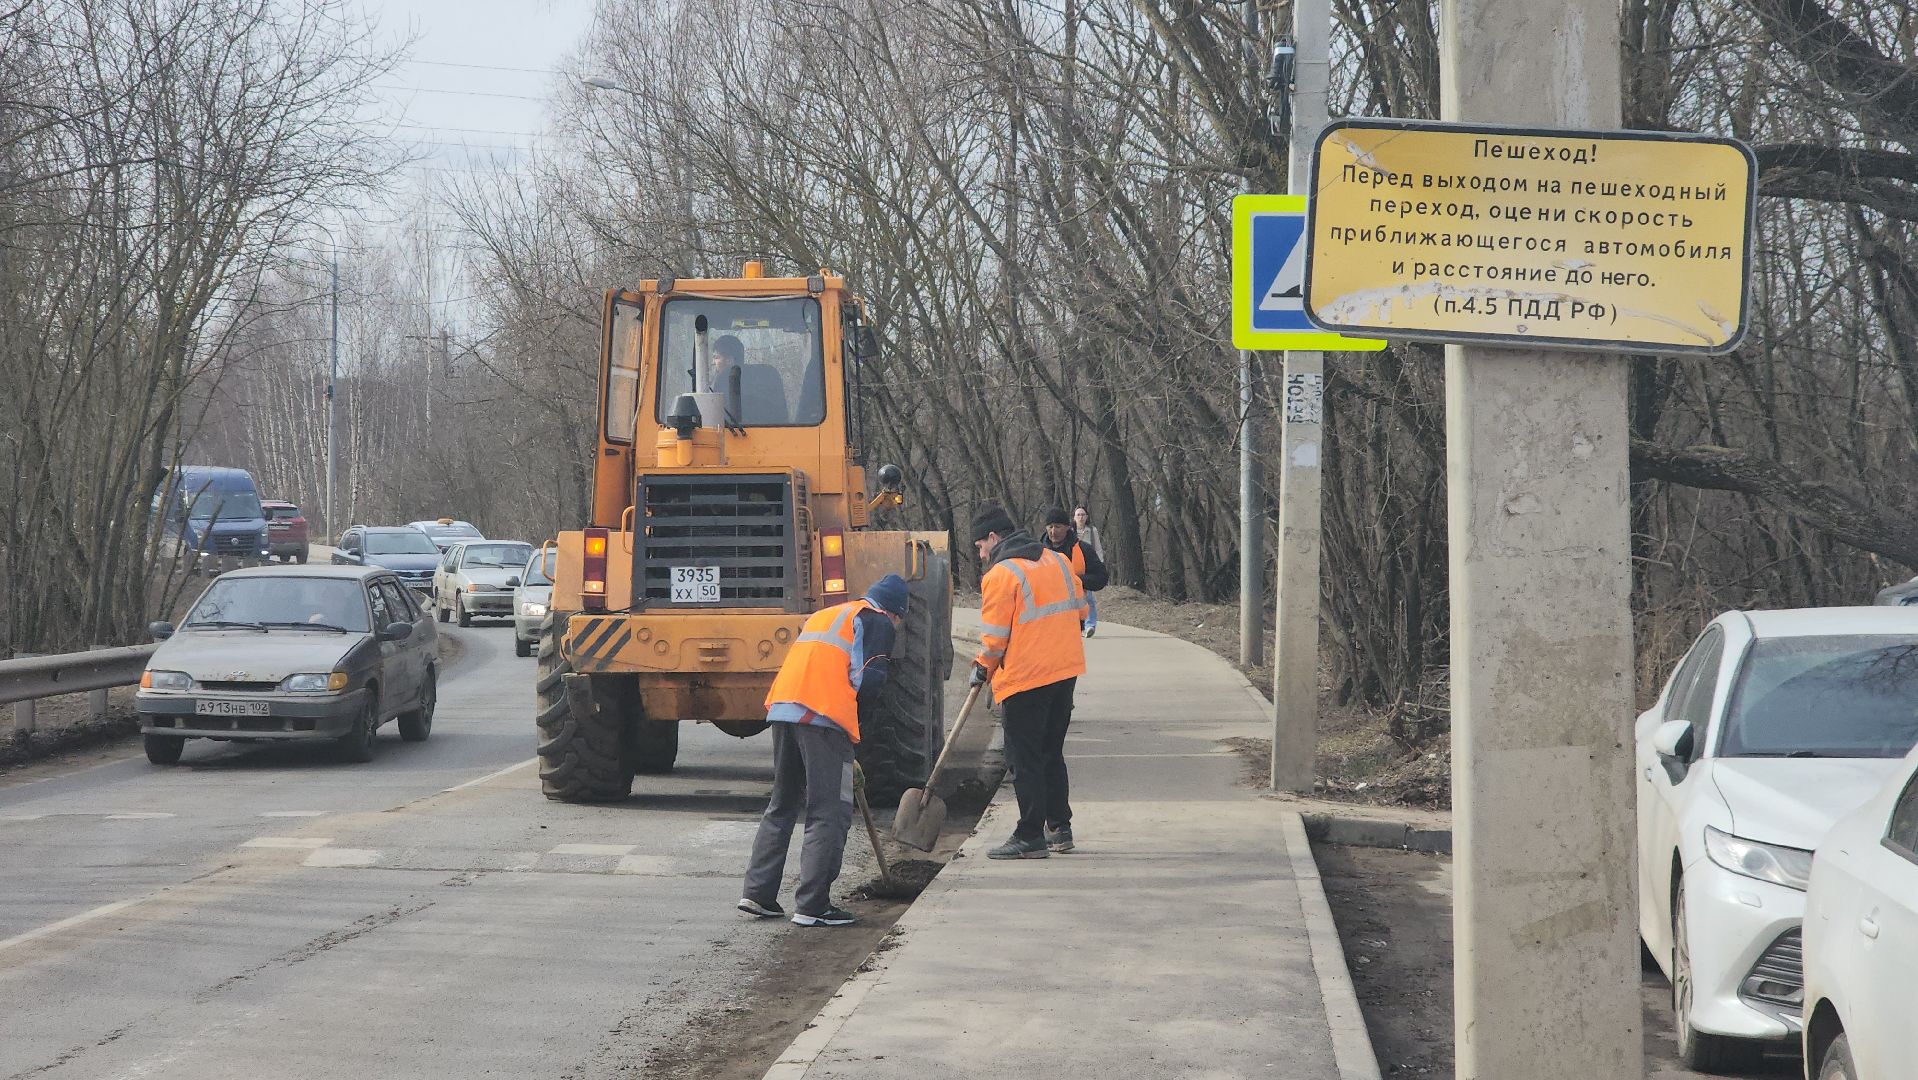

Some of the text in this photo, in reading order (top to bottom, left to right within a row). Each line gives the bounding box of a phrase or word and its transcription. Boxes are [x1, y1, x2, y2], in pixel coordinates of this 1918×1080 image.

[1475, 139, 1597, 162] Пешеход!
[1342, 164, 1727, 201] Перед выходом на пешеходный
[1370, 198, 1694, 229] переход, оцени скорость
[1330, 225, 1732, 260] приближающегося автомобиля
[1392, 260, 1656, 288] и расстояние до него.
[1434, 294, 1618, 326] (п.4.5 ПДД РФ)
[677, 568, 714, 582] 3935
[675, 585, 716, 600] ХХ 50
[199, 702, 268, 714] А913НВ 102
